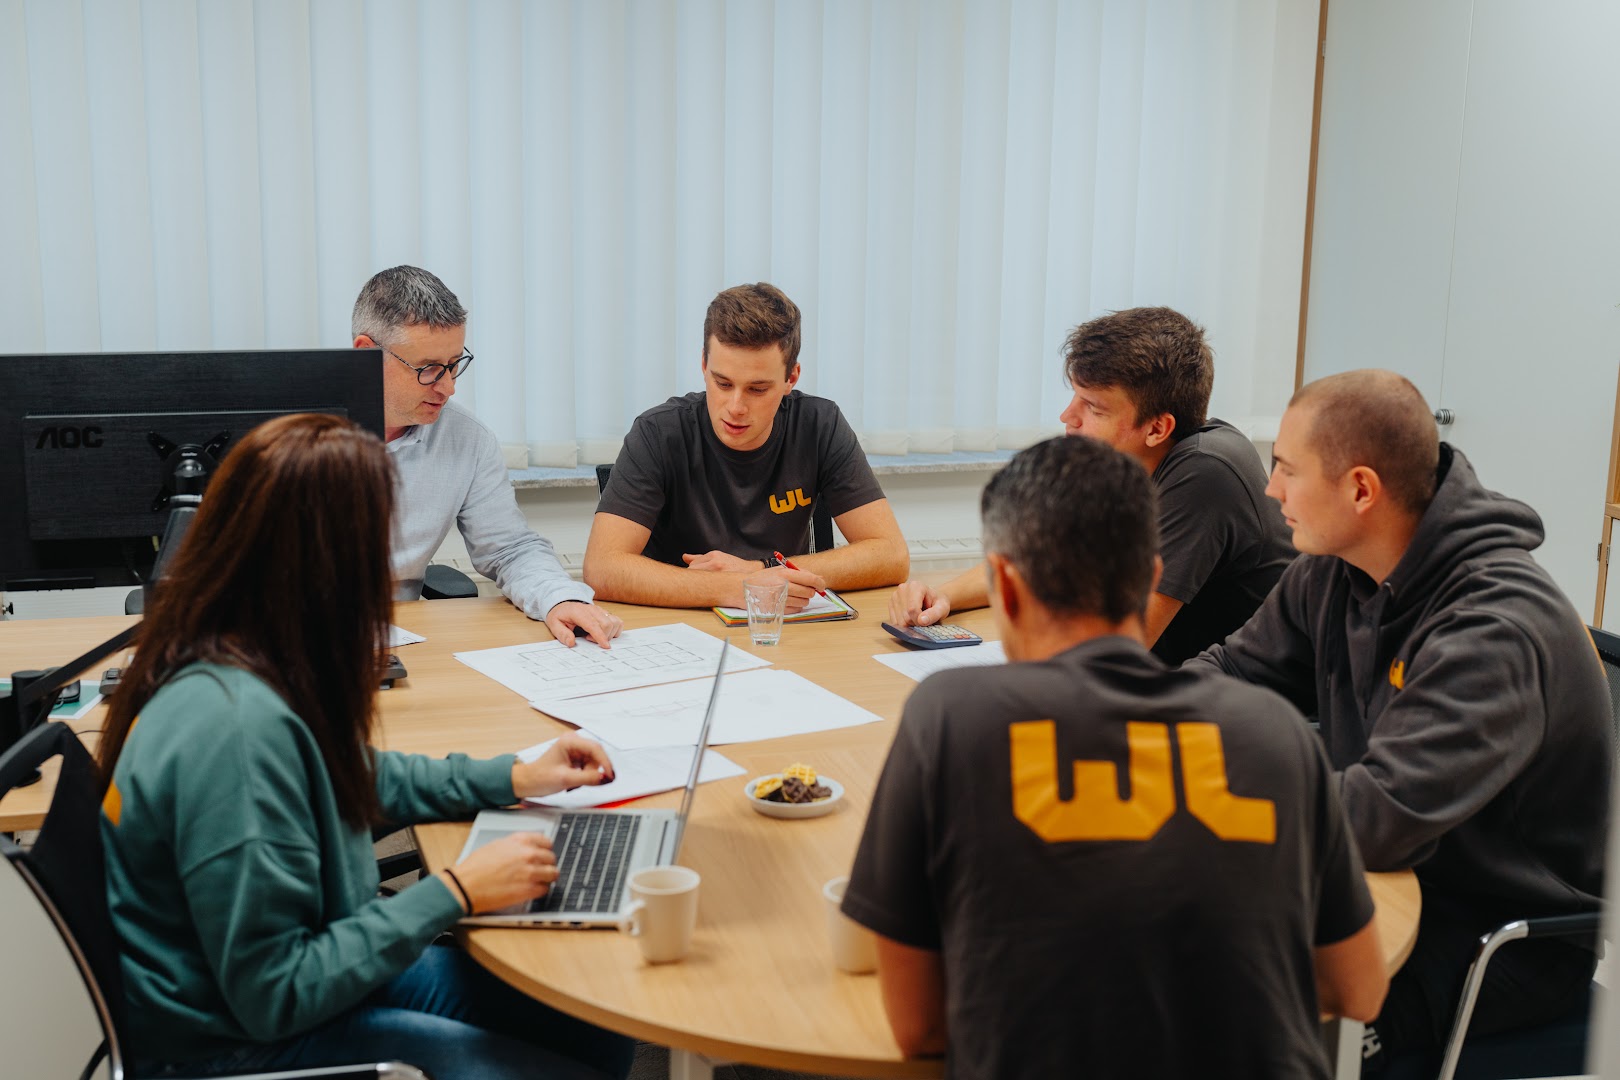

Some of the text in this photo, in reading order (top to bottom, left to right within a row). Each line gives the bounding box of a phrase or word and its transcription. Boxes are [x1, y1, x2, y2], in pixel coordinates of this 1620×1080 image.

[36, 426, 103, 449] AOC
[769, 488, 811, 514] WL
[1009, 719, 1277, 844] WL
